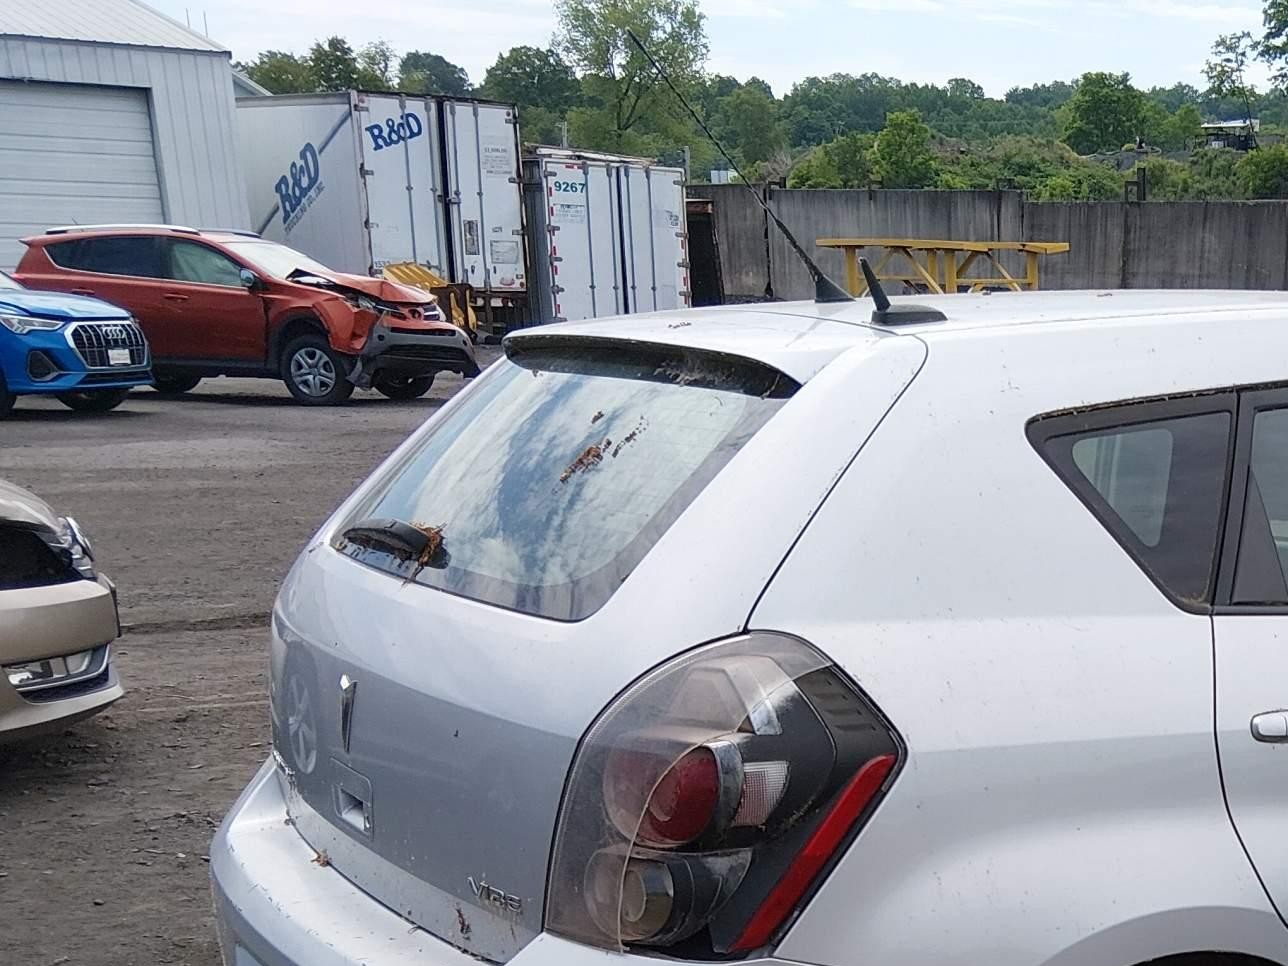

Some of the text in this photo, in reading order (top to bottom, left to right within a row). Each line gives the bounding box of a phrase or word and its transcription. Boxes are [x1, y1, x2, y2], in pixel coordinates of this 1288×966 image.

[365, 112, 423, 151] R&D
[275, 142, 319, 225] R&D
[553, 180, 586, 193] 9267
